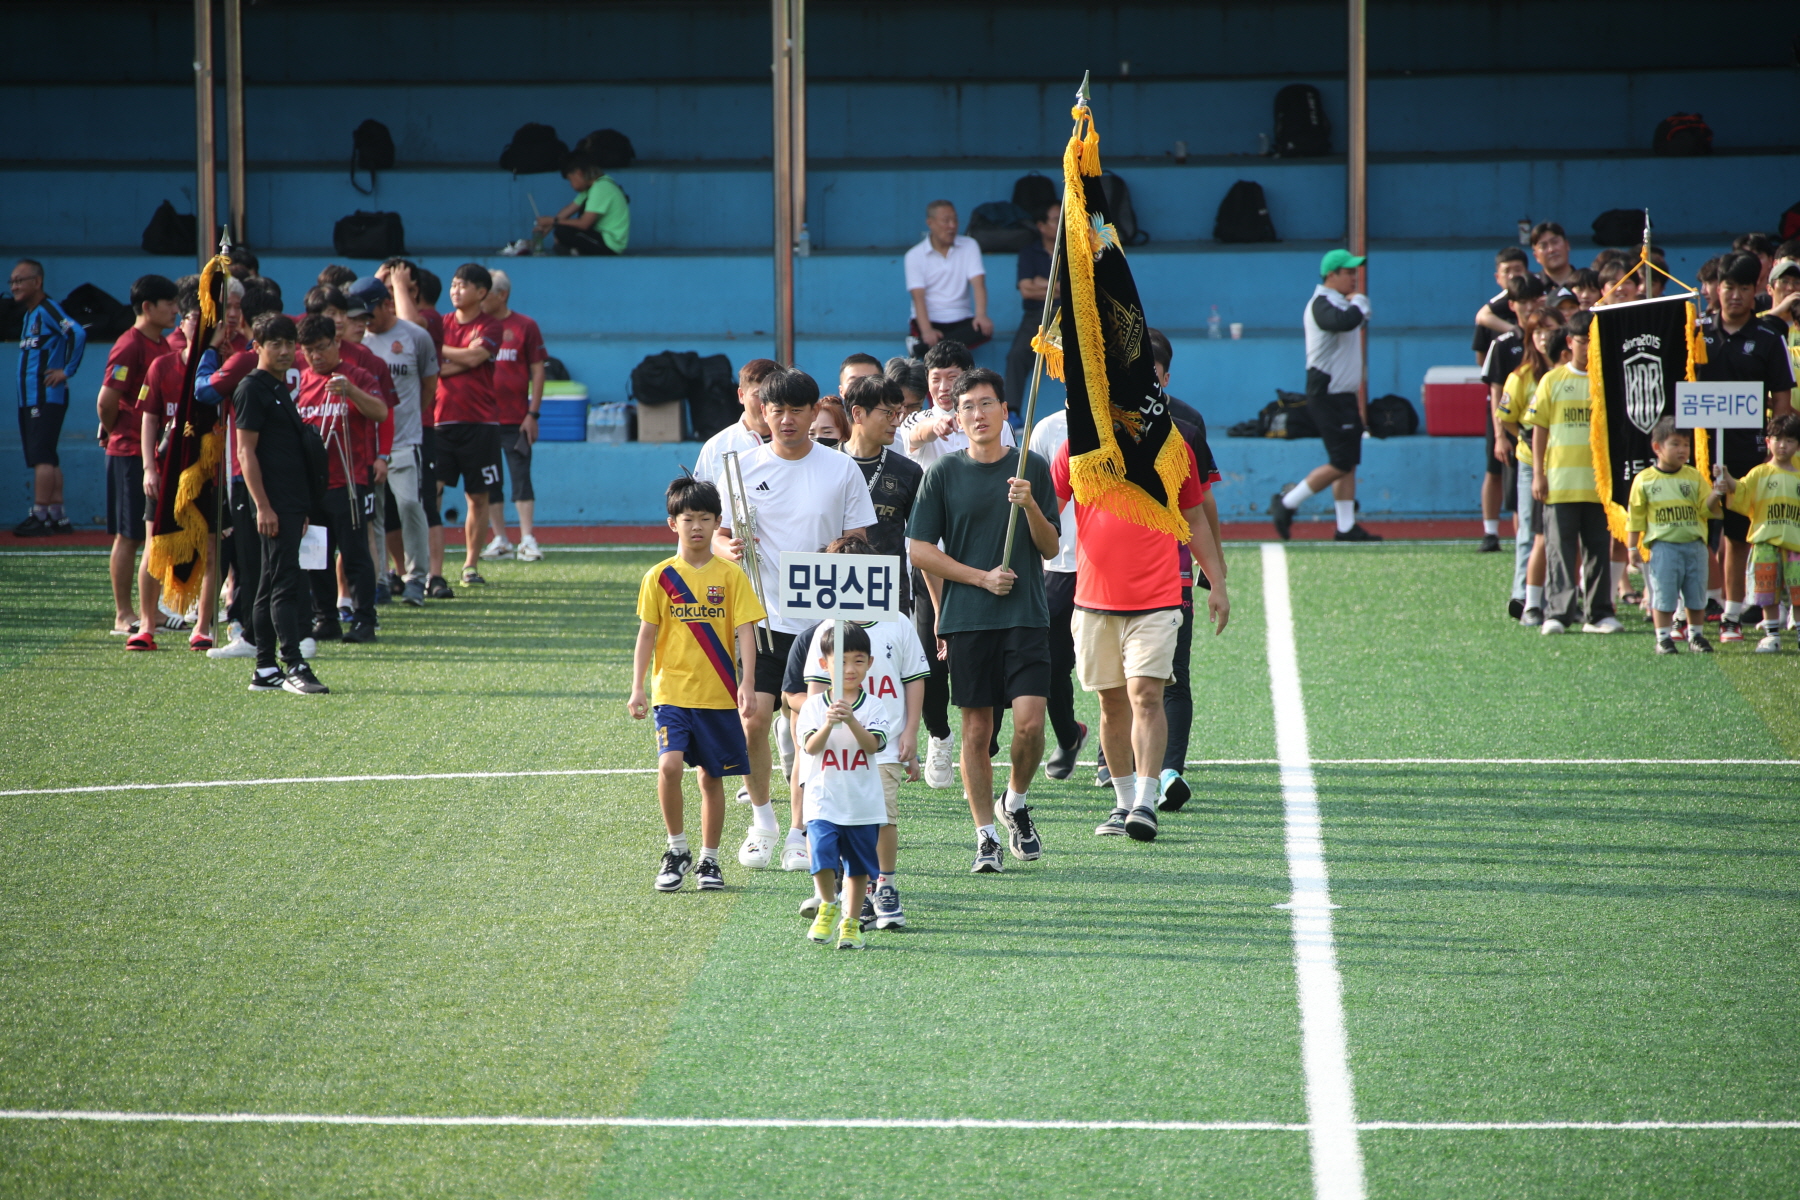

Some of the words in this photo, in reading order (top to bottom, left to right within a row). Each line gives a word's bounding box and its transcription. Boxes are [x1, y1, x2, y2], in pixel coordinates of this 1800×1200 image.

[1682, 394, 1758, 416] 곰두리FC
[481, 464, 499, 485] 51
[787, 564, 892, 611] 모닝스타
[669, 604, 725, 618] Rakuten
[858, 675, 898, 699] IA
[821, 749, 870, 771] AIA
